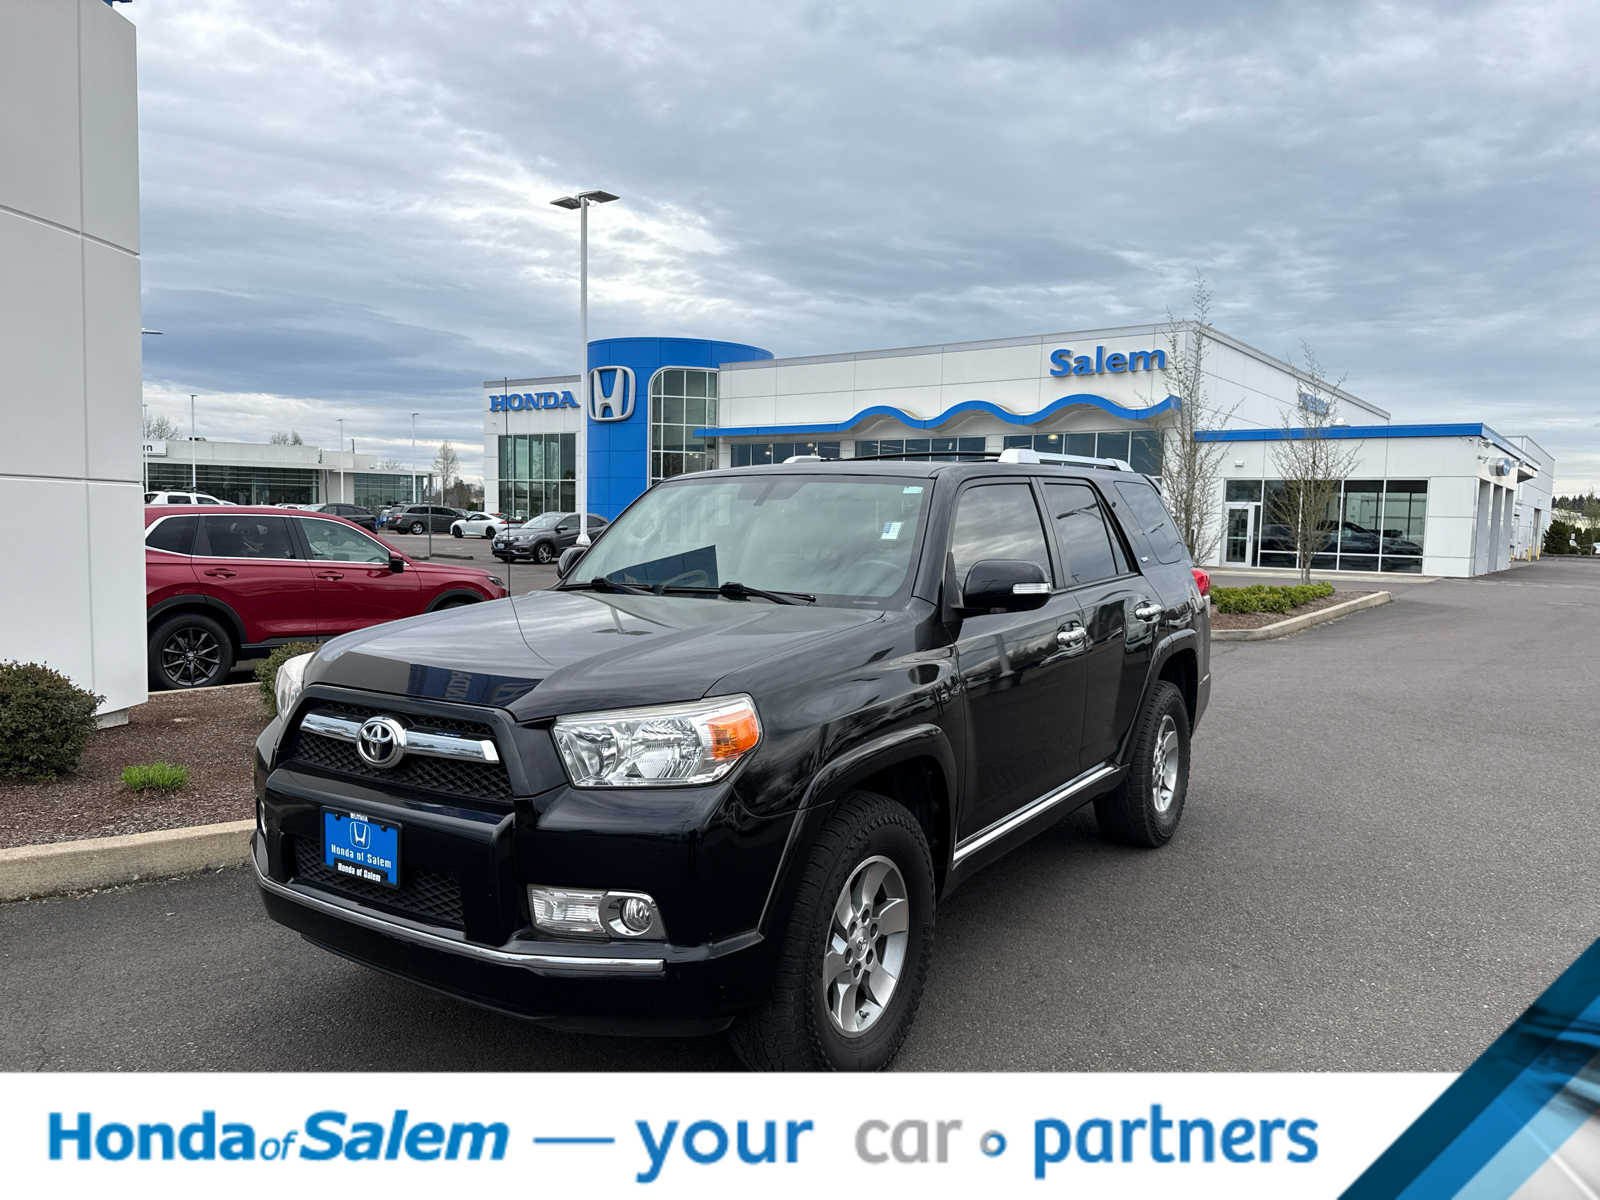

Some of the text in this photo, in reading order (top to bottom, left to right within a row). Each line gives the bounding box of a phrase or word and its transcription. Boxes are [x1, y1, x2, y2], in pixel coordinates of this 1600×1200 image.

[1049, 345, 1166, 377] Salem
[489, 390, 580, 412] HONDA
[330, 843, 354, 859] Honda
[367, 853, 392, 869] Salem
